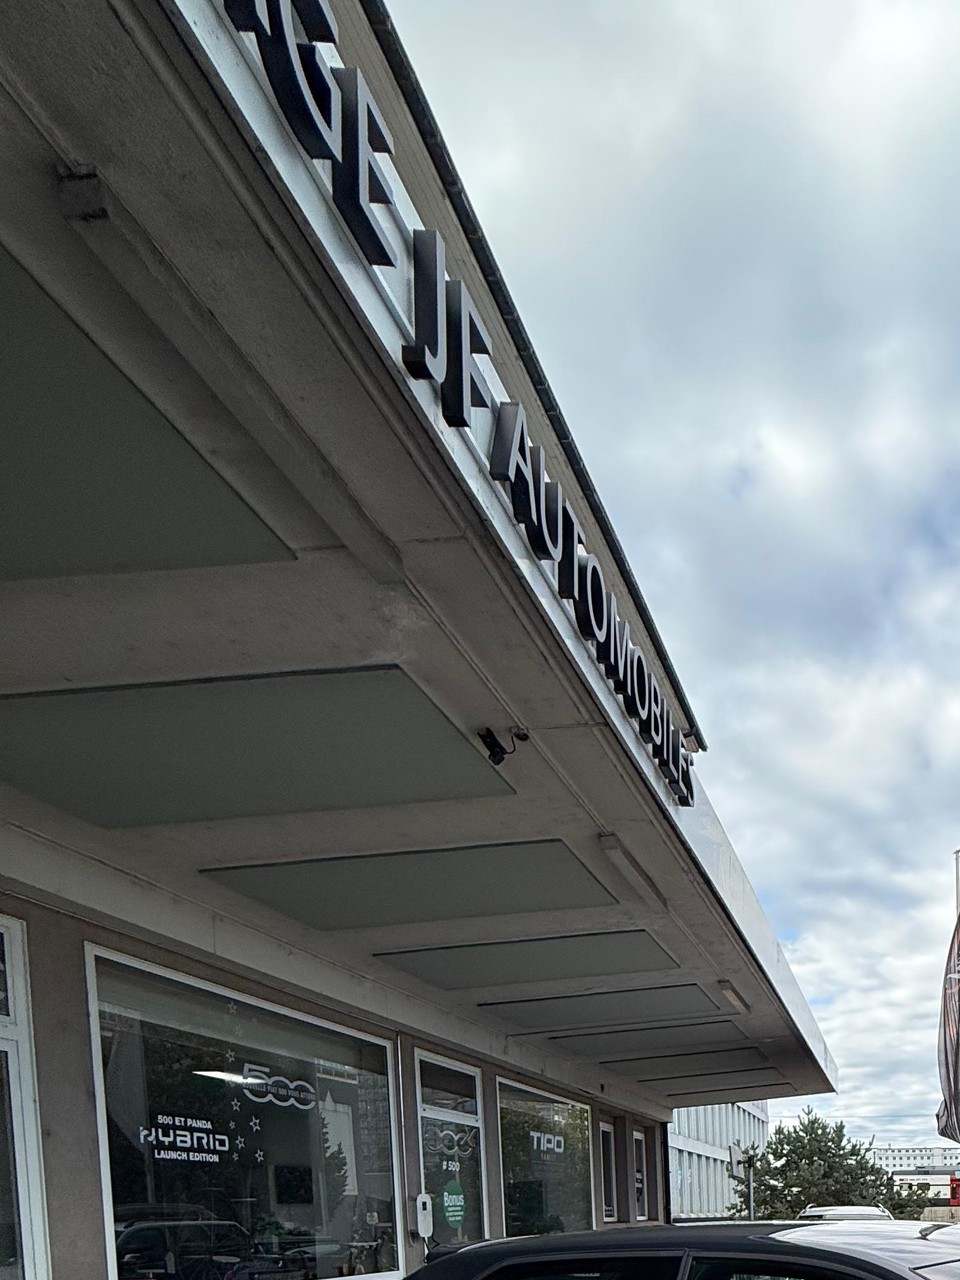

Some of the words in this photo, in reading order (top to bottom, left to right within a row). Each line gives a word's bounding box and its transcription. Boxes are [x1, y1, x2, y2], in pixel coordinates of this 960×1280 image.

[225, 0, 397, 268] GE
[402, 229, 493, 428] JF
[490, 401, 696, 808] AUTOMOBILES
[158, 1115, 173, 1125] 500
[175, 1116, 185, 1126] ET
[187, 1118, 213, 1130] PANDA
[140, 1126, 229, 1152] HYBRID
[530, 1131, 564, 1153] TIPO
[154, 1149, 188, 1161] LAUNCH
[189, 1151, 219, 1163] EDITION
[448, 1161, 460, 1171] 500
[443, 1191, 465, 1207] Bonus
